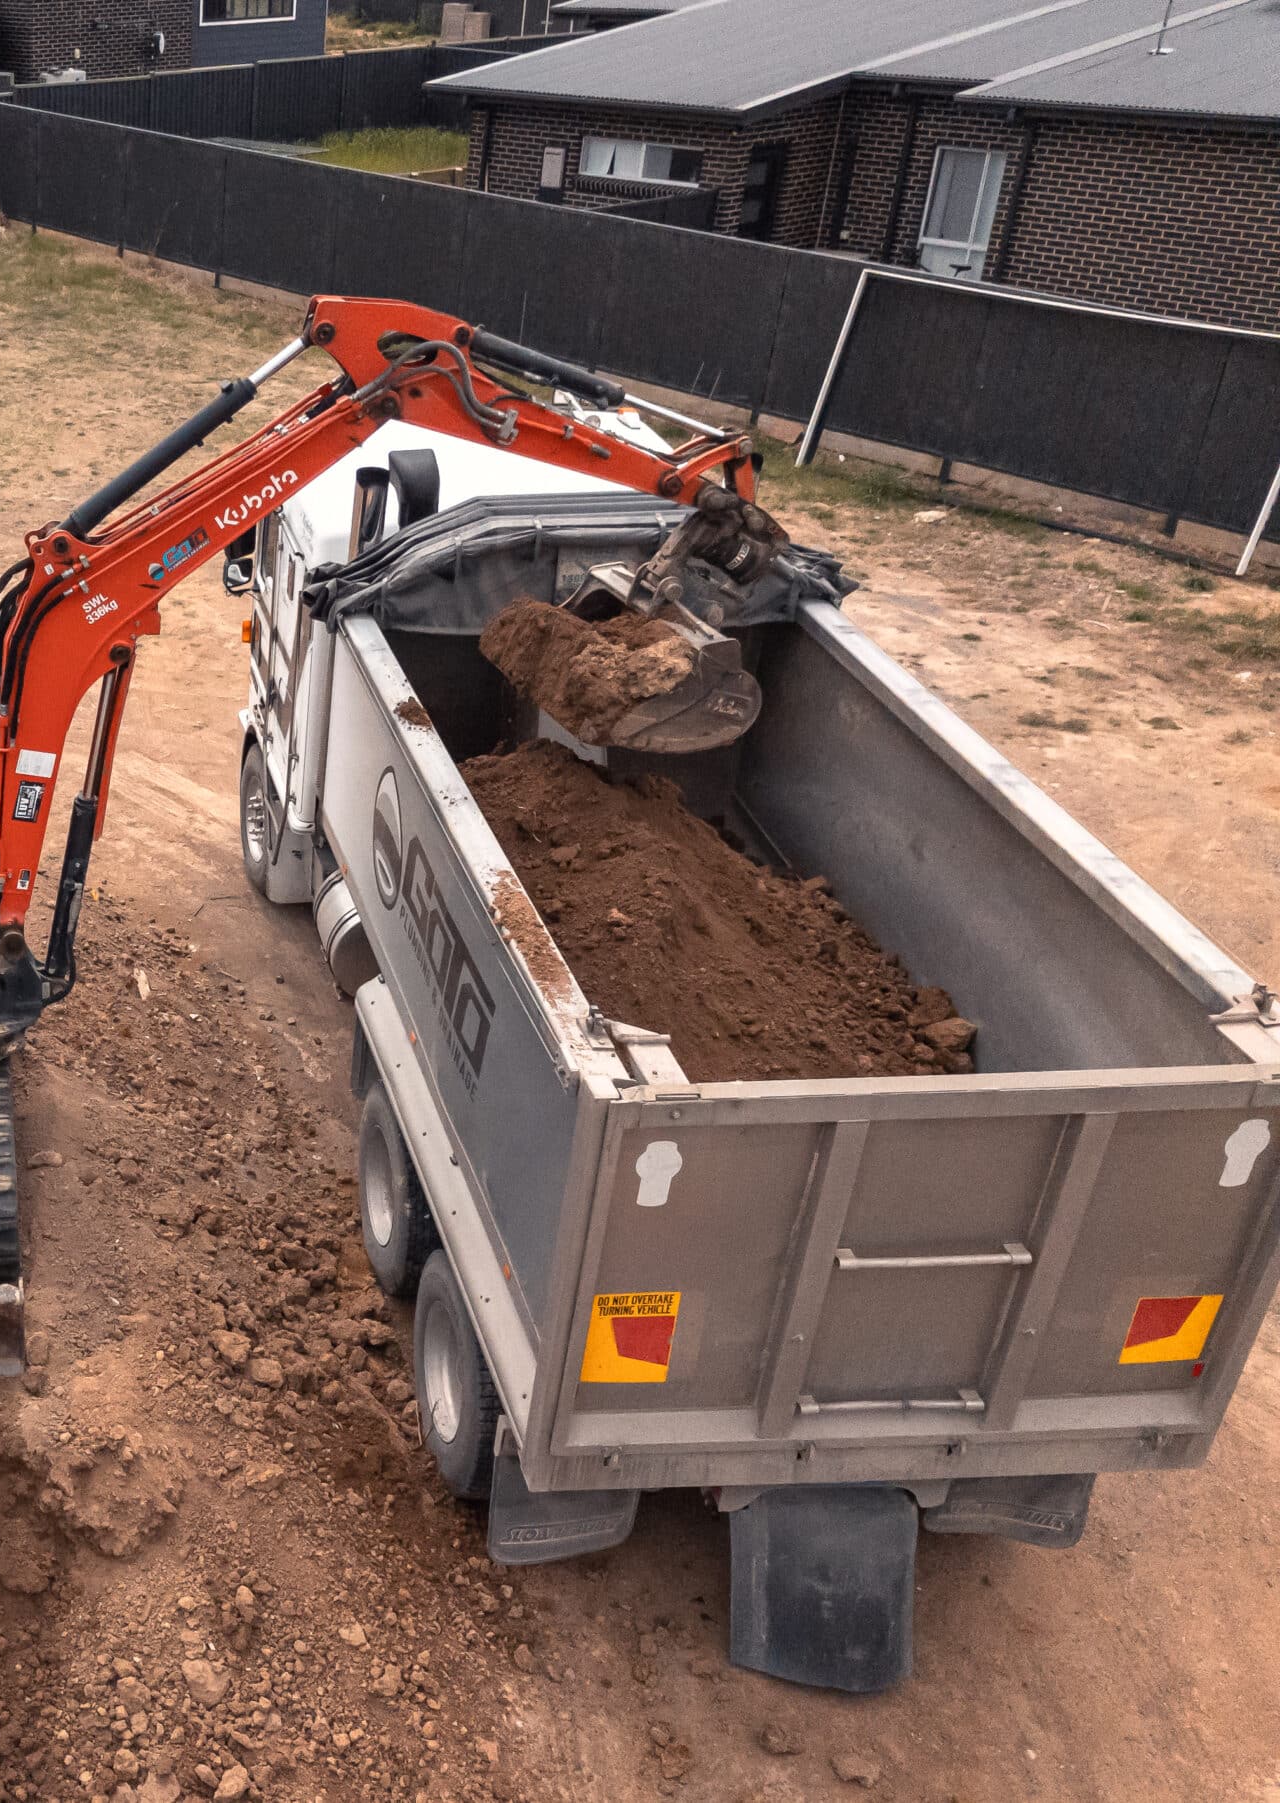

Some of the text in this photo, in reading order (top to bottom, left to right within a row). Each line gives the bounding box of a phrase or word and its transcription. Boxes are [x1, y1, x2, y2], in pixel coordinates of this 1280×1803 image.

[214, 469, 298, 530] Kubota
[82, 593, 109, 613] SWL
[85, 599, 119, 624] 336kg
[598, 1294, 674, 1306] DO NOT OVERTAKE
[599, 1304, 672, 1316] TURNING VEHICLE
